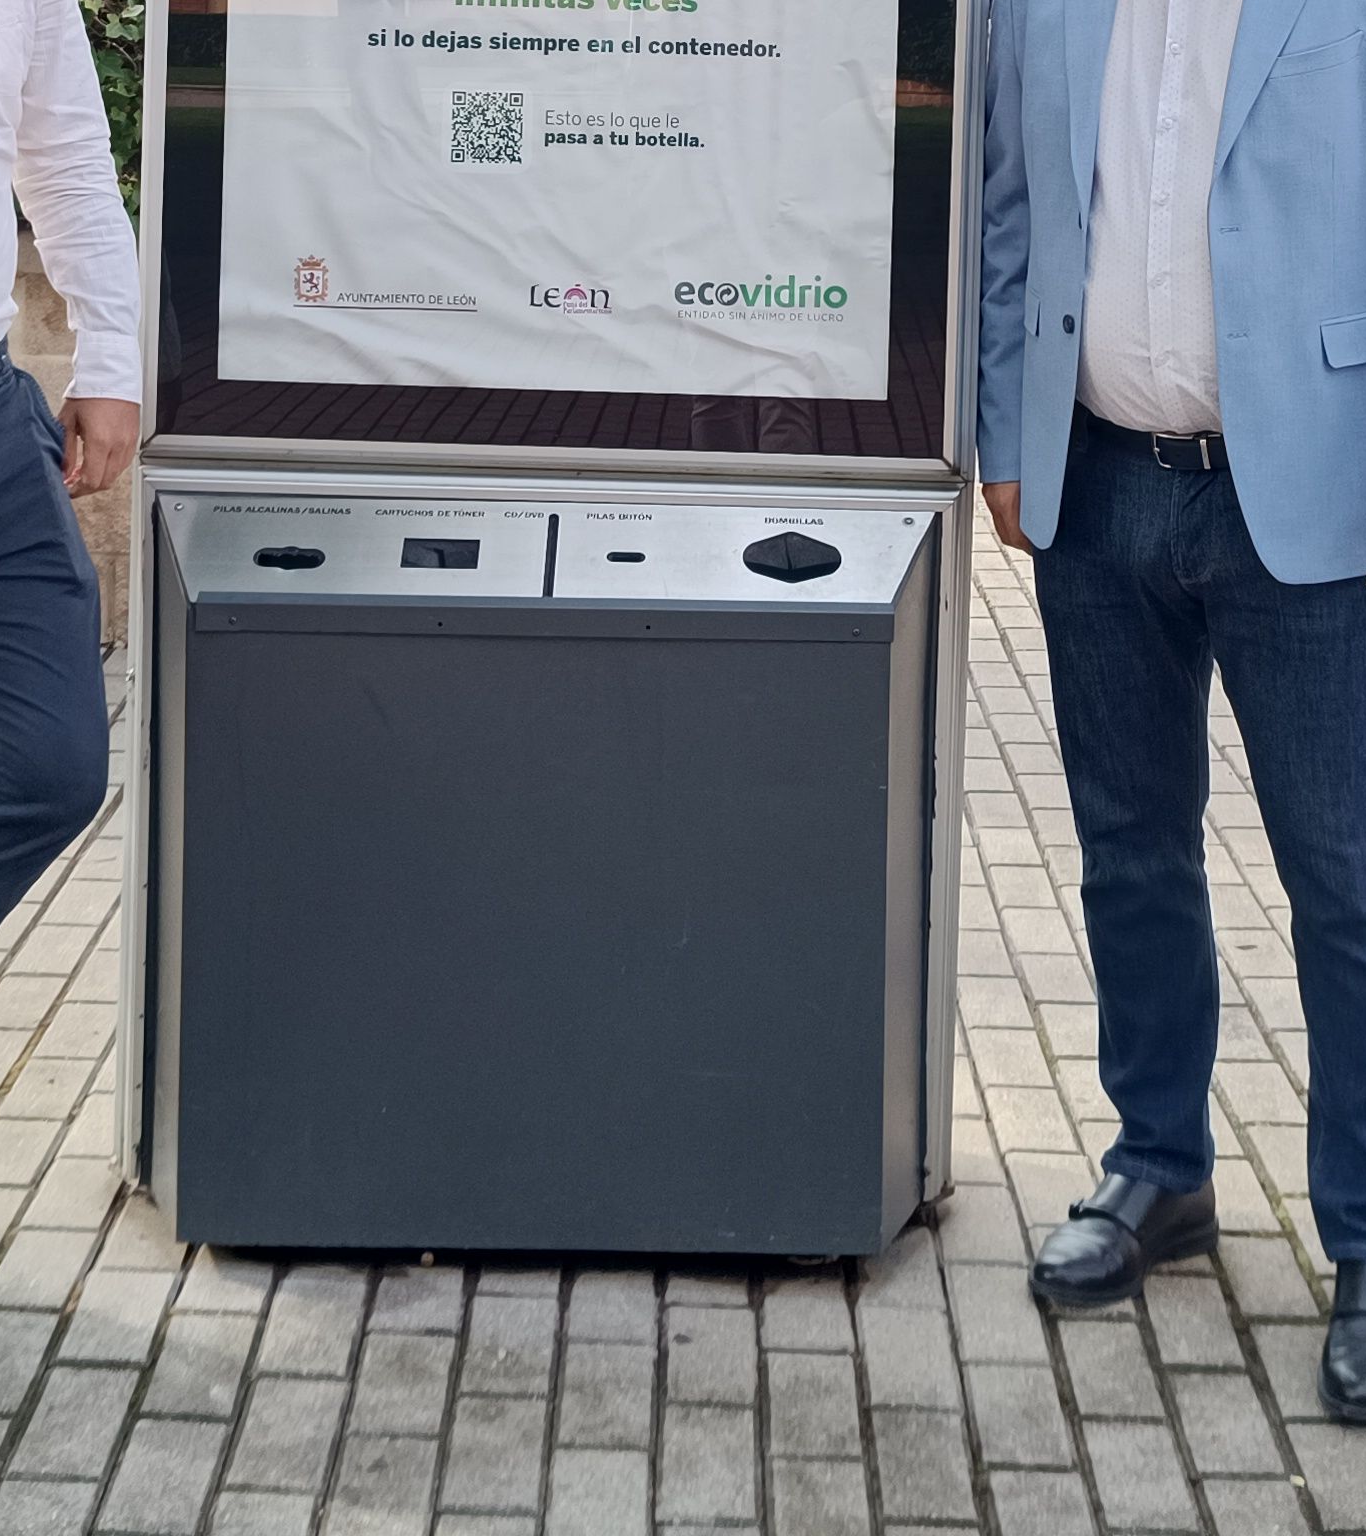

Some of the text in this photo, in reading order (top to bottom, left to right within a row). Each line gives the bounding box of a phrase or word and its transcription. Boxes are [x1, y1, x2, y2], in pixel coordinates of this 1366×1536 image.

[367, 28, 782, 58] si lo dejas siempre en el contenedor.
[545, 109, 680, 131] Esto es lo que le
[544, 131, 705, 148] pasa a tu botella.
[674, 274, 848, 309] ecovidrio
[336, 292, 477, 306] AYUNTAMIENTO DE LEÓN
[677, 310, 725, 320] ENTIDAD
[728, 311, 747, 321] SIN
[789, 312, 803, 322] DE
[806, 313, 844, 323] LUCRO
[212, 505, 242, 513] PILAS
[375, 508, 434, 517] CARTUCHOS
[437, 509, 452, 517] DE
[586, 512, 615, 521] PILAS
